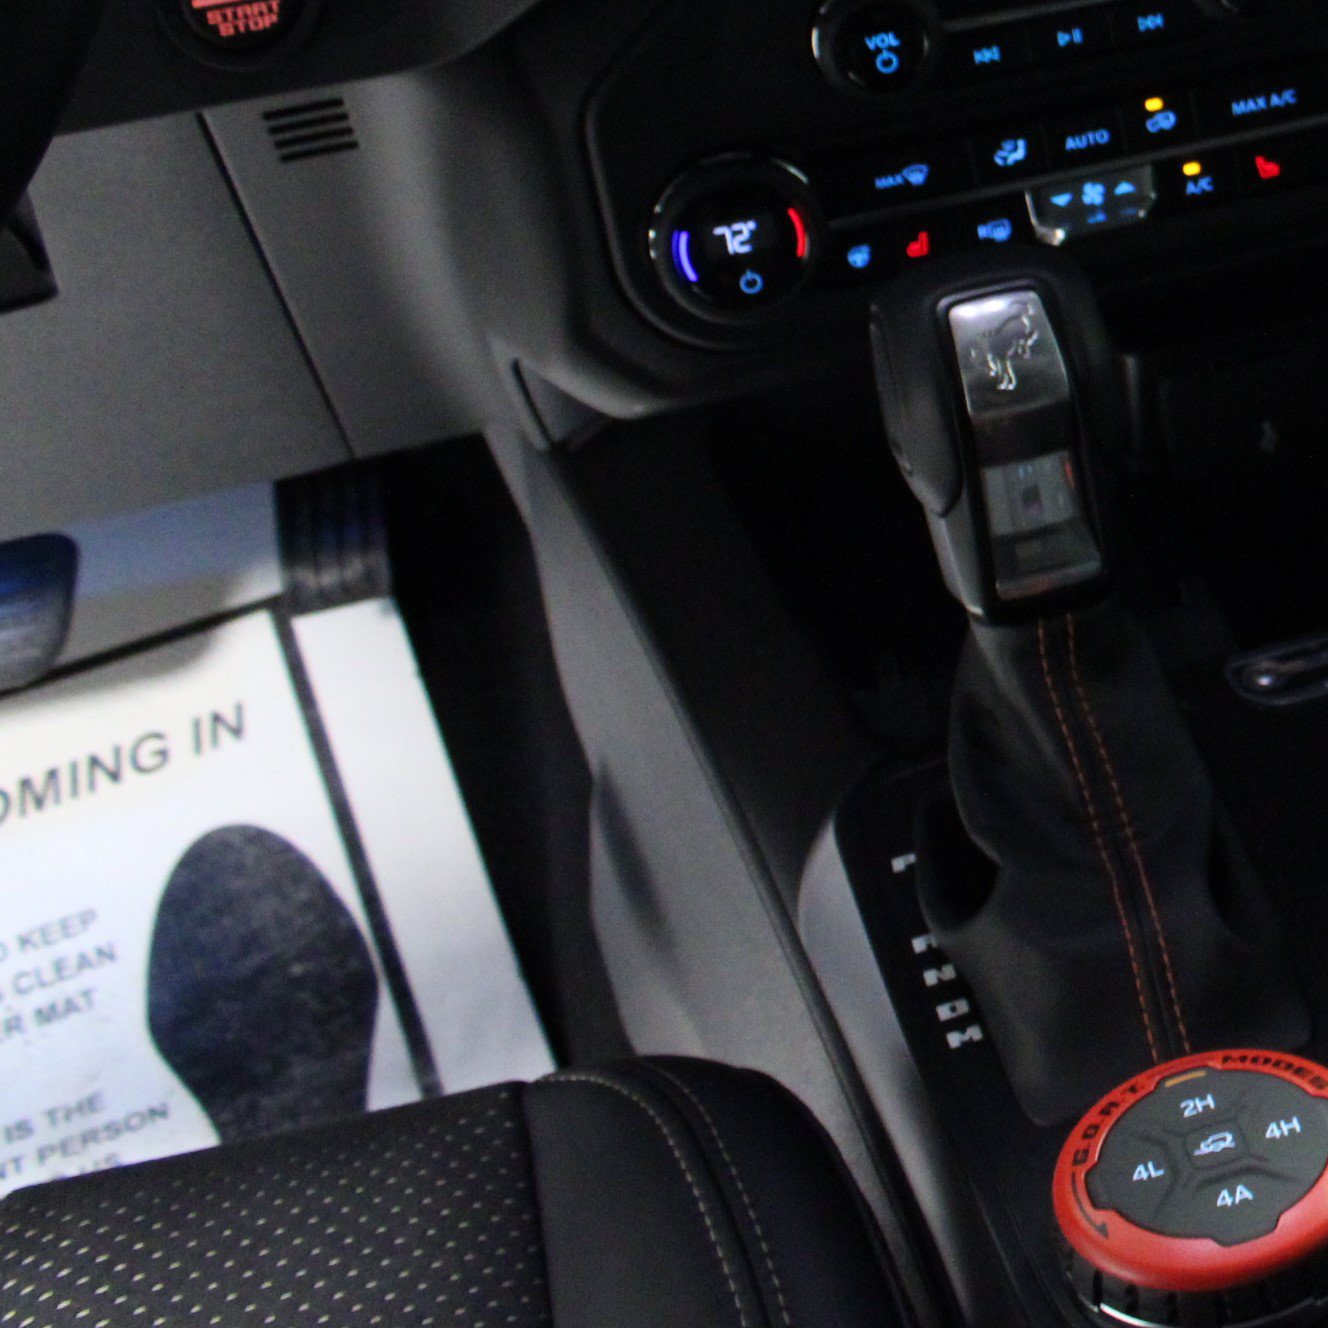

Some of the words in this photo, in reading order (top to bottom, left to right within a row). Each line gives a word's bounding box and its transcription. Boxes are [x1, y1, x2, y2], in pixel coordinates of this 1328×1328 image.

[216, 13, 280, 37] STOP
[864, 30, 901, 53] VOL
[1230, 95, 1267, 116] MAX
[1268, 88, 1298, 111] A/C
[1065, 128, 1110, 152] AUTO
[1184, 175, 1215, 196] A/C
[190, 700, 246, 758] IN
[16, 908, 98, 953] KEEP
[12, 940, 117, 996] CLEAN
[33, 986, 96, 1029] MAT
[3, 1118, 35, 1144] IS
[45, 1091, 103, 1128] THE
[1179, 1092, 1218, 1120] 2H
[36, 1101, 170, 1165] PERSON
[1264, 1115, 1303, 1142] 4H
[1131, 1159, 1166, 1183] 4L
[1215, 1183, 1255, 1209] 4A
